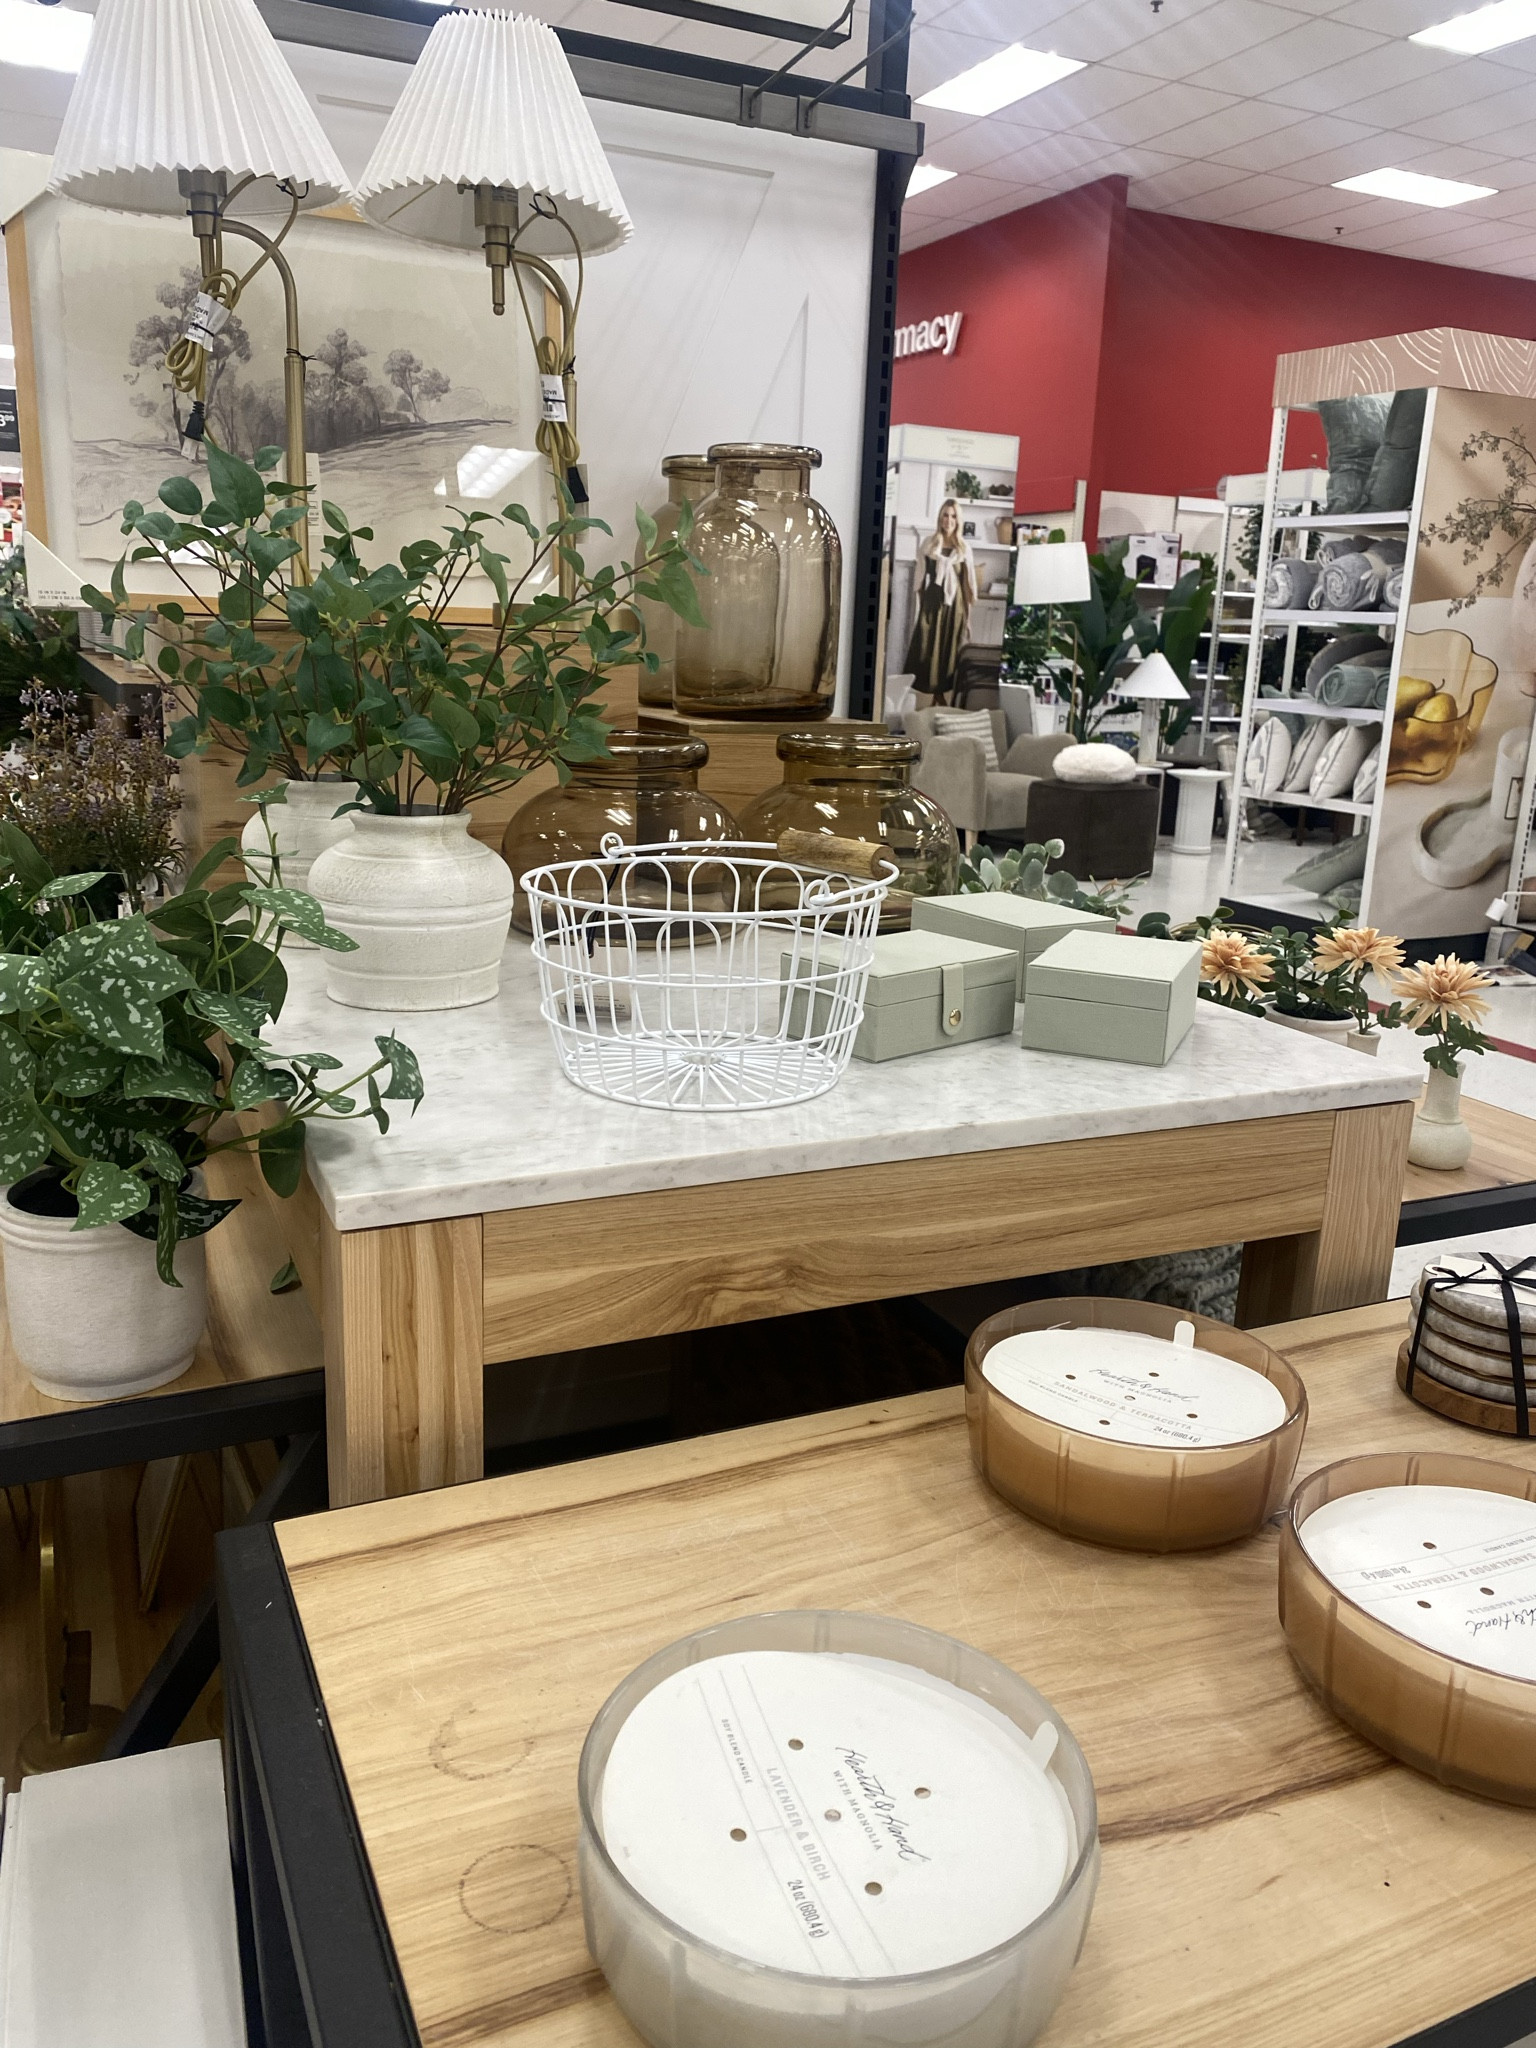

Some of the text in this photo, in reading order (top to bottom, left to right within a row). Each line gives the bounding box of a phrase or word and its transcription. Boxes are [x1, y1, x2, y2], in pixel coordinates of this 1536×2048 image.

[1088, 1368, 1148, 1387] Hearth
[1148, 1387, 1200, 1403] Hand
[1103, 1379, 1172, 1404] WITH MAGNOLIA
[1054, 1381, 1192, 1431] SANDALWOOD & TERRACOTTA
[1153, 1425, 1163, 1433] 24
[1399, 1565, 1411, 1574] 24
[1469, 1552, 1536, 1576] SANDALWOOD
[1393, 1573, 1459, 1591] TERRACOTTA
[1467, 1600, 1515, 1614] MAGNOLIA
[1513, 1610, 1526, 1625] &
[1465, 1612, 1512, 1637] Hand
[722, 1718, 753, 1784] SOY BLEND CANDLE
[833, 1769, 883, 1851] WITH MAGNOLIA
[835, 1746, 932, 1862] Hearth & Hand
[766, 1767, 831, 1881] LAVENDER & BIRCH
[787, 1879, 805, 1892] 24
[792, 1890, 806, 1901] oz
